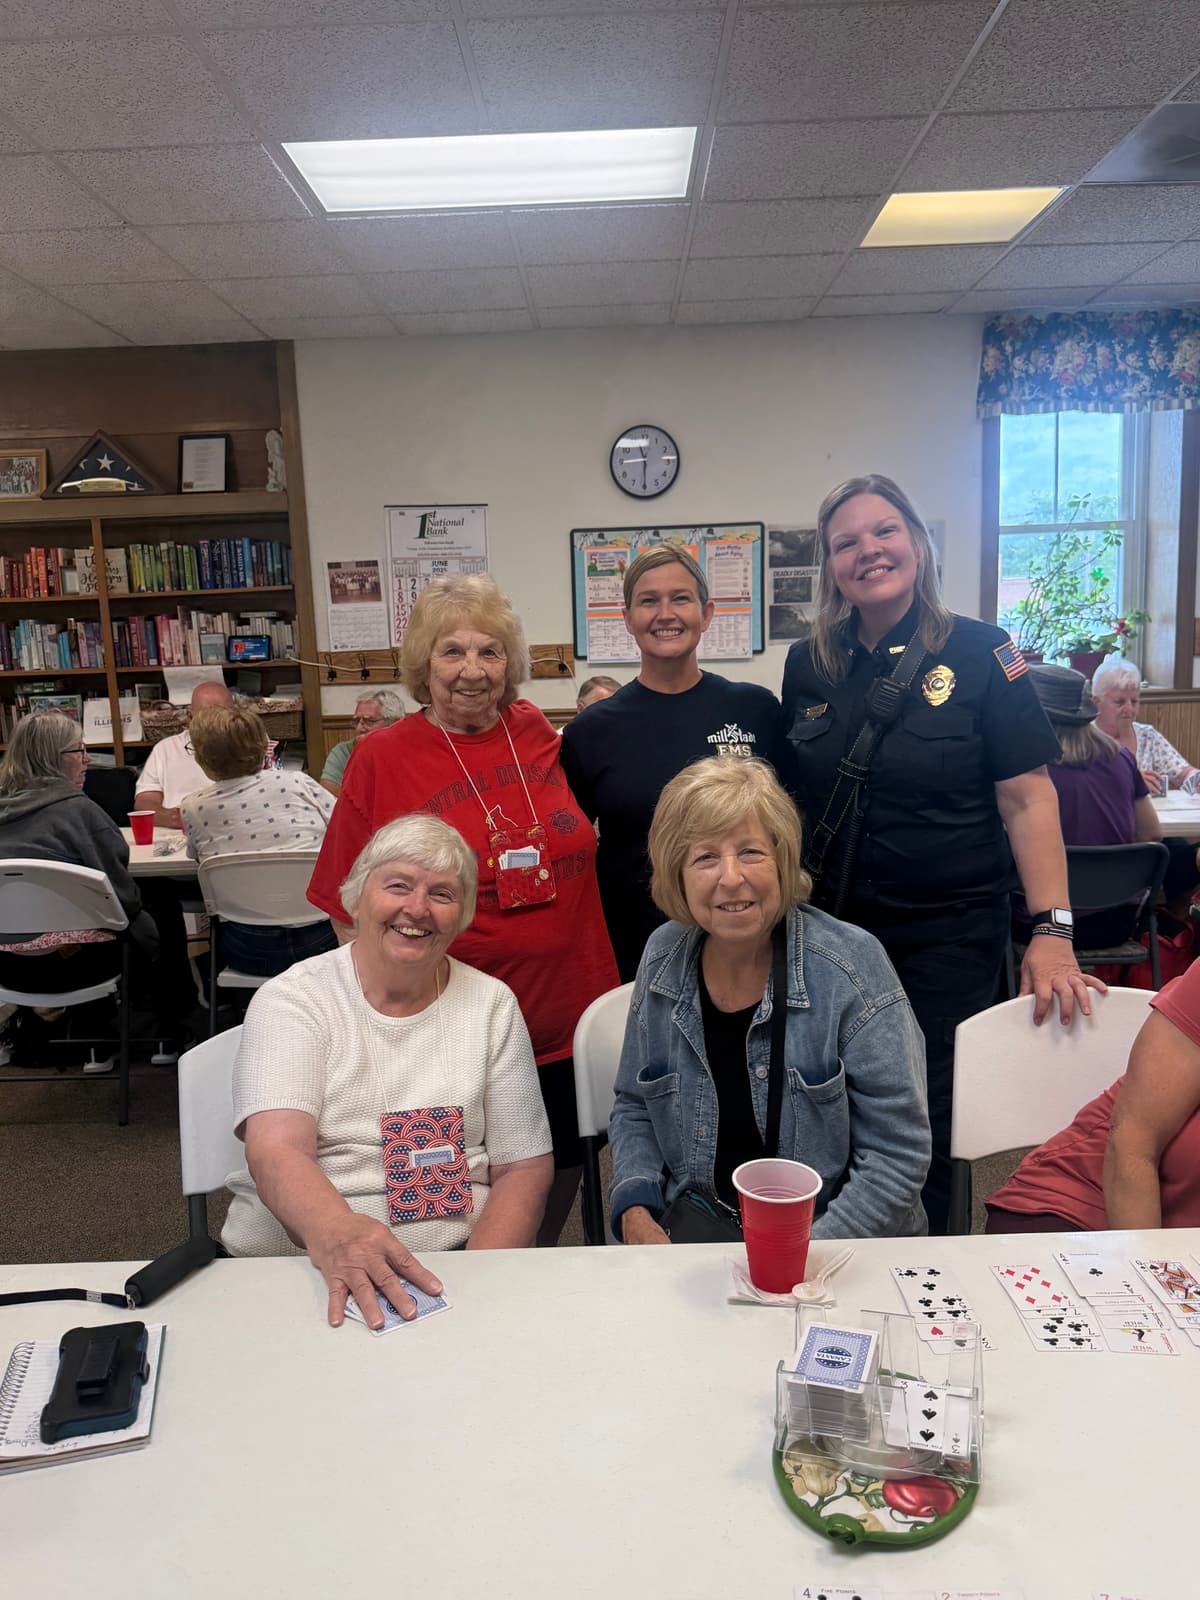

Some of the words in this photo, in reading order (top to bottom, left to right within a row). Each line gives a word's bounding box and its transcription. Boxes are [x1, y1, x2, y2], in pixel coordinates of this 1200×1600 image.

[413, 511, 436, 539] 1st
[427, 518, 465, 527] National
[426, 527, 448, 536] Bank
[411, 578, 416, 590] 2
[398, 592, 403, 603] 8
[396, 604, 406, 616] 15
[396, 618, 408, 629] 22
[94, 716, 132, 726] ILLIIS
[718, 745, 751, 756] EMS
[816, 1353, 852, 1362] CANASTA
[803, 1588, 811, 1598] 4
